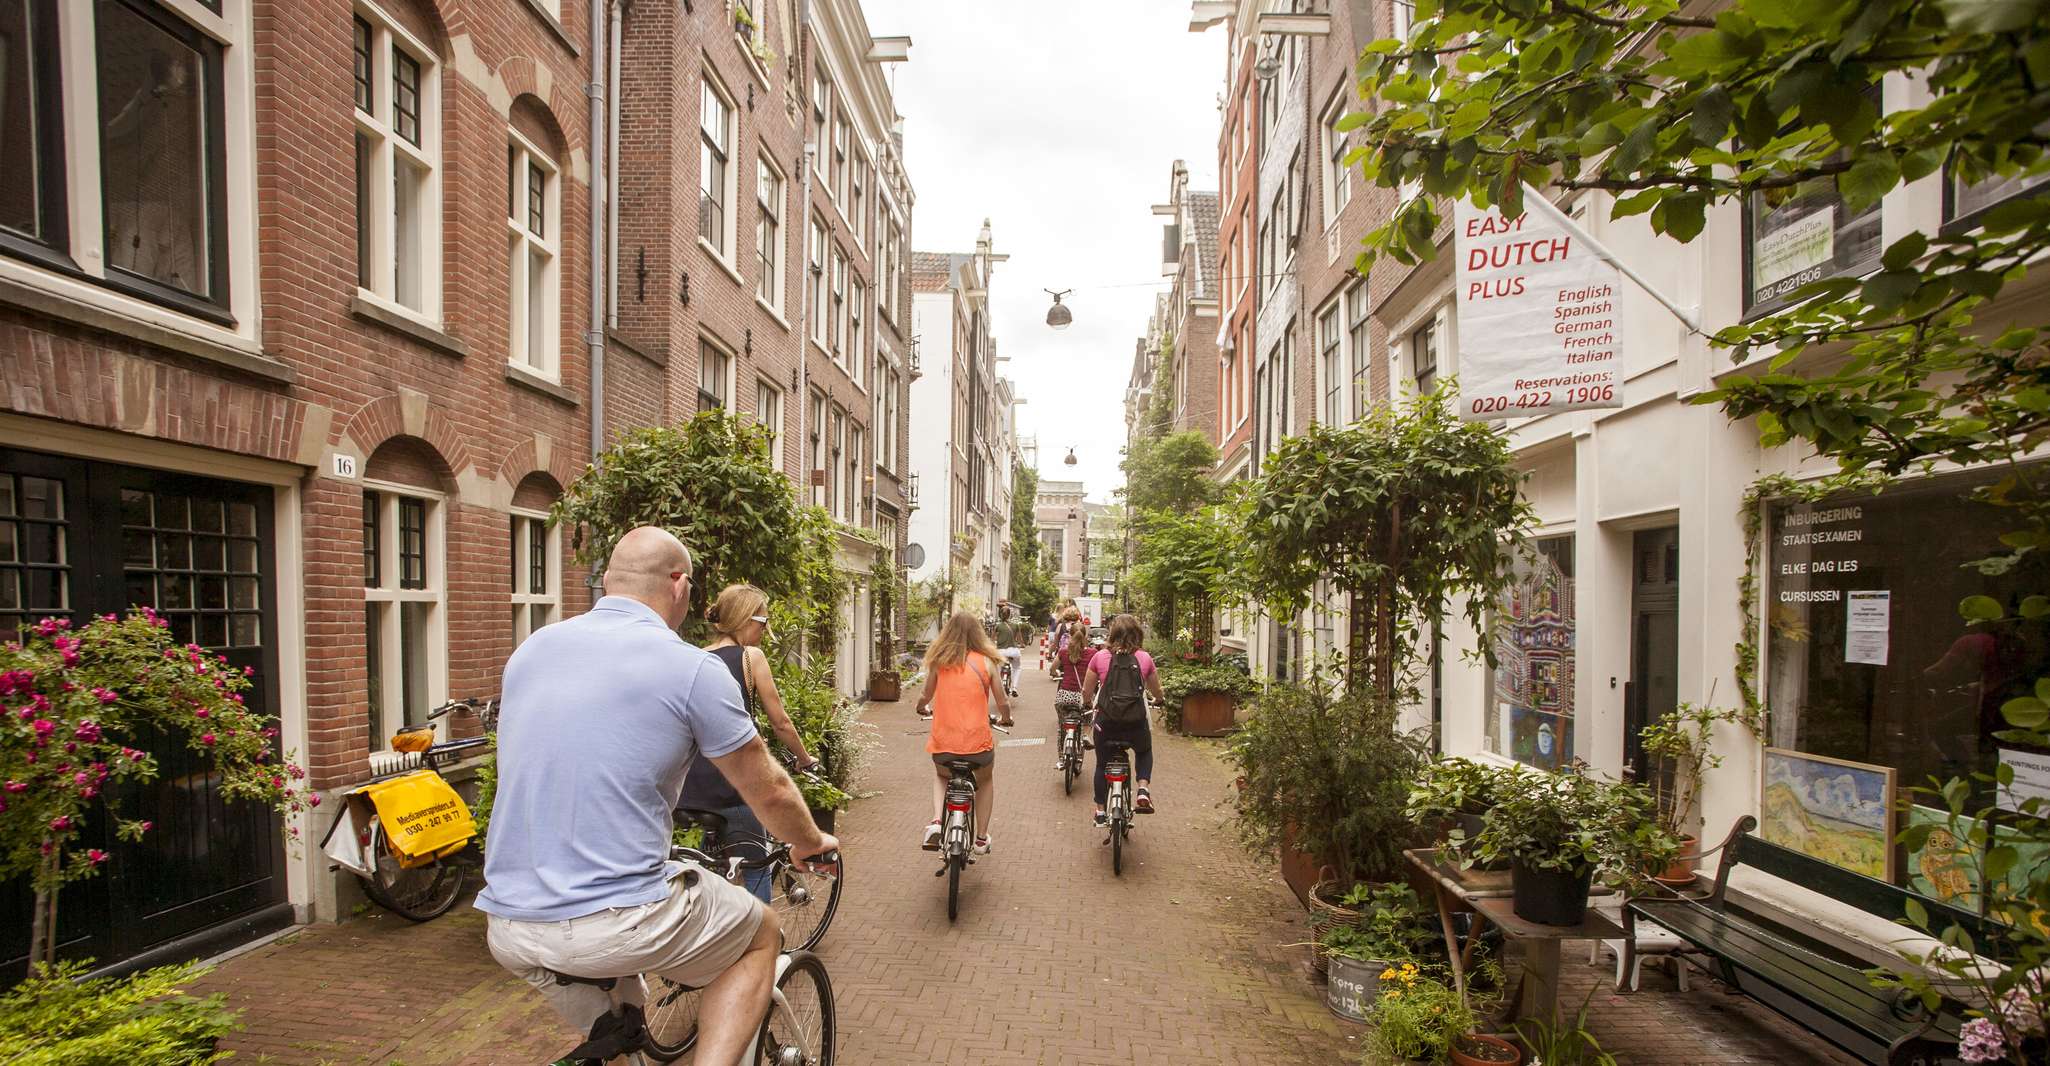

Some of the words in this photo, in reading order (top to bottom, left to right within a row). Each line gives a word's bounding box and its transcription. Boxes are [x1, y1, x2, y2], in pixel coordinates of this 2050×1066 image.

[1466, 212, 1528, 237] EASY
[1468, 236, 1570, 271] DUTCH
[1468, 277, 1525, 300] PLUS
[1558, 284, 1612, 303] English
[1757, 287, 1774, 303] 020
[1775, 267, 1821, 295] 4221906
[1554, 300, 1612, 320] Spanish
[1554, 319, 1612, 334] German
[1564, 332, 1613, 349] French
[1567, 350, 1613, 364] Italian
[1514, 371, 1613, 390] Reservations:
[1471, 391, 1552, 413] 020-422
[1566, 384, 1614, 404] 1906
[338, 458, 352, 474] 16
[1785, 506, 1863, 527] INBURGERING
[1782, 530, 1862, 545] STAATSEXAMEN
[1781, 563, 1807, 575] ELKE
[1812, 561, 1835, 573] DAG
[1837, 560, 1858, 572] LES
[1780, 590, 1840, 602] CURSUSSEN
[405, 823, 423, 836] 030
[429, 816, 441, 828] 247
[1329, 965, 1364, 993] lcome
